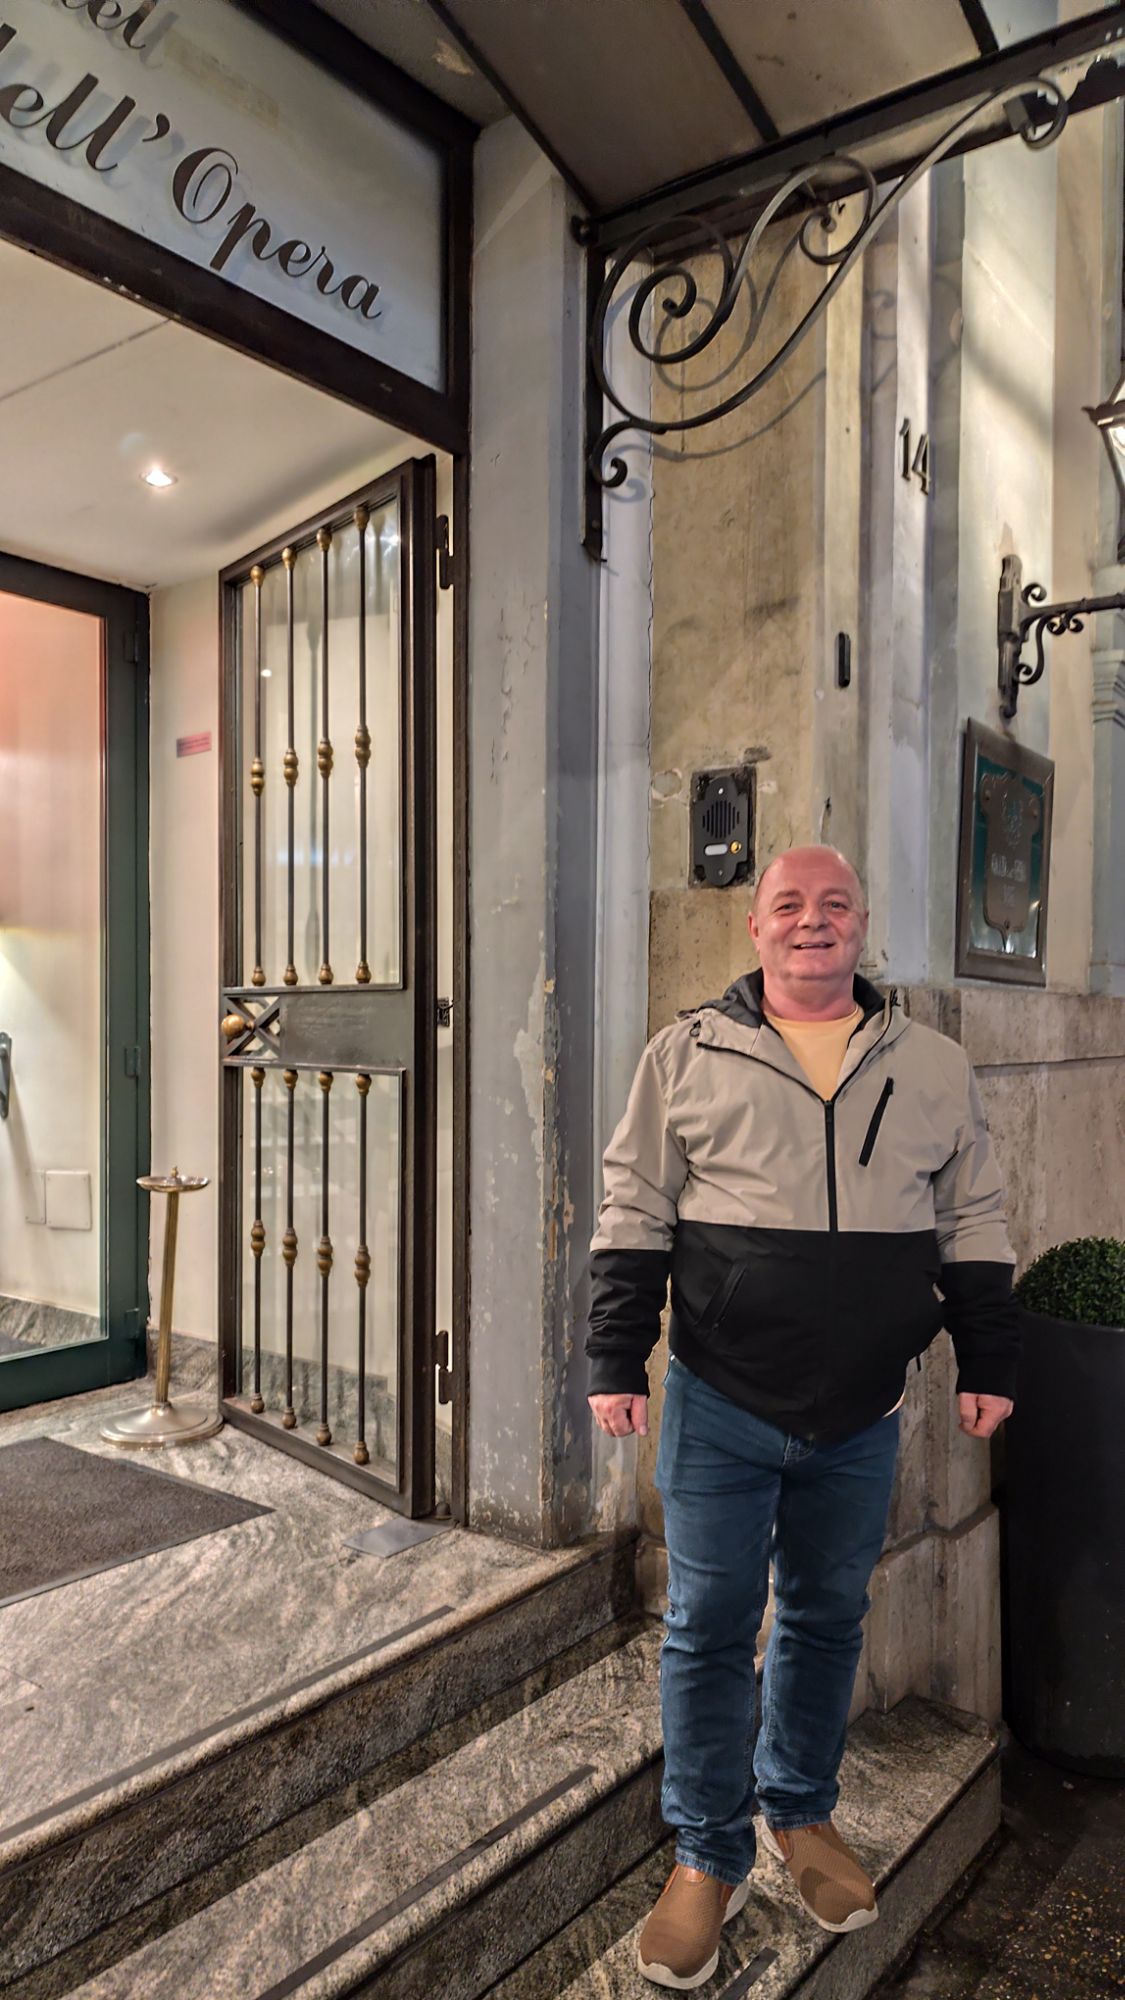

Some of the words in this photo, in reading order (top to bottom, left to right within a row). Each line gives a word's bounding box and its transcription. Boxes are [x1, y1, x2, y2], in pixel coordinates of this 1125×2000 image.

[60, 0, 156, 49] el
[0, 23, 382, 320] ell'Opera
[899, 418, 929, 496] 14
